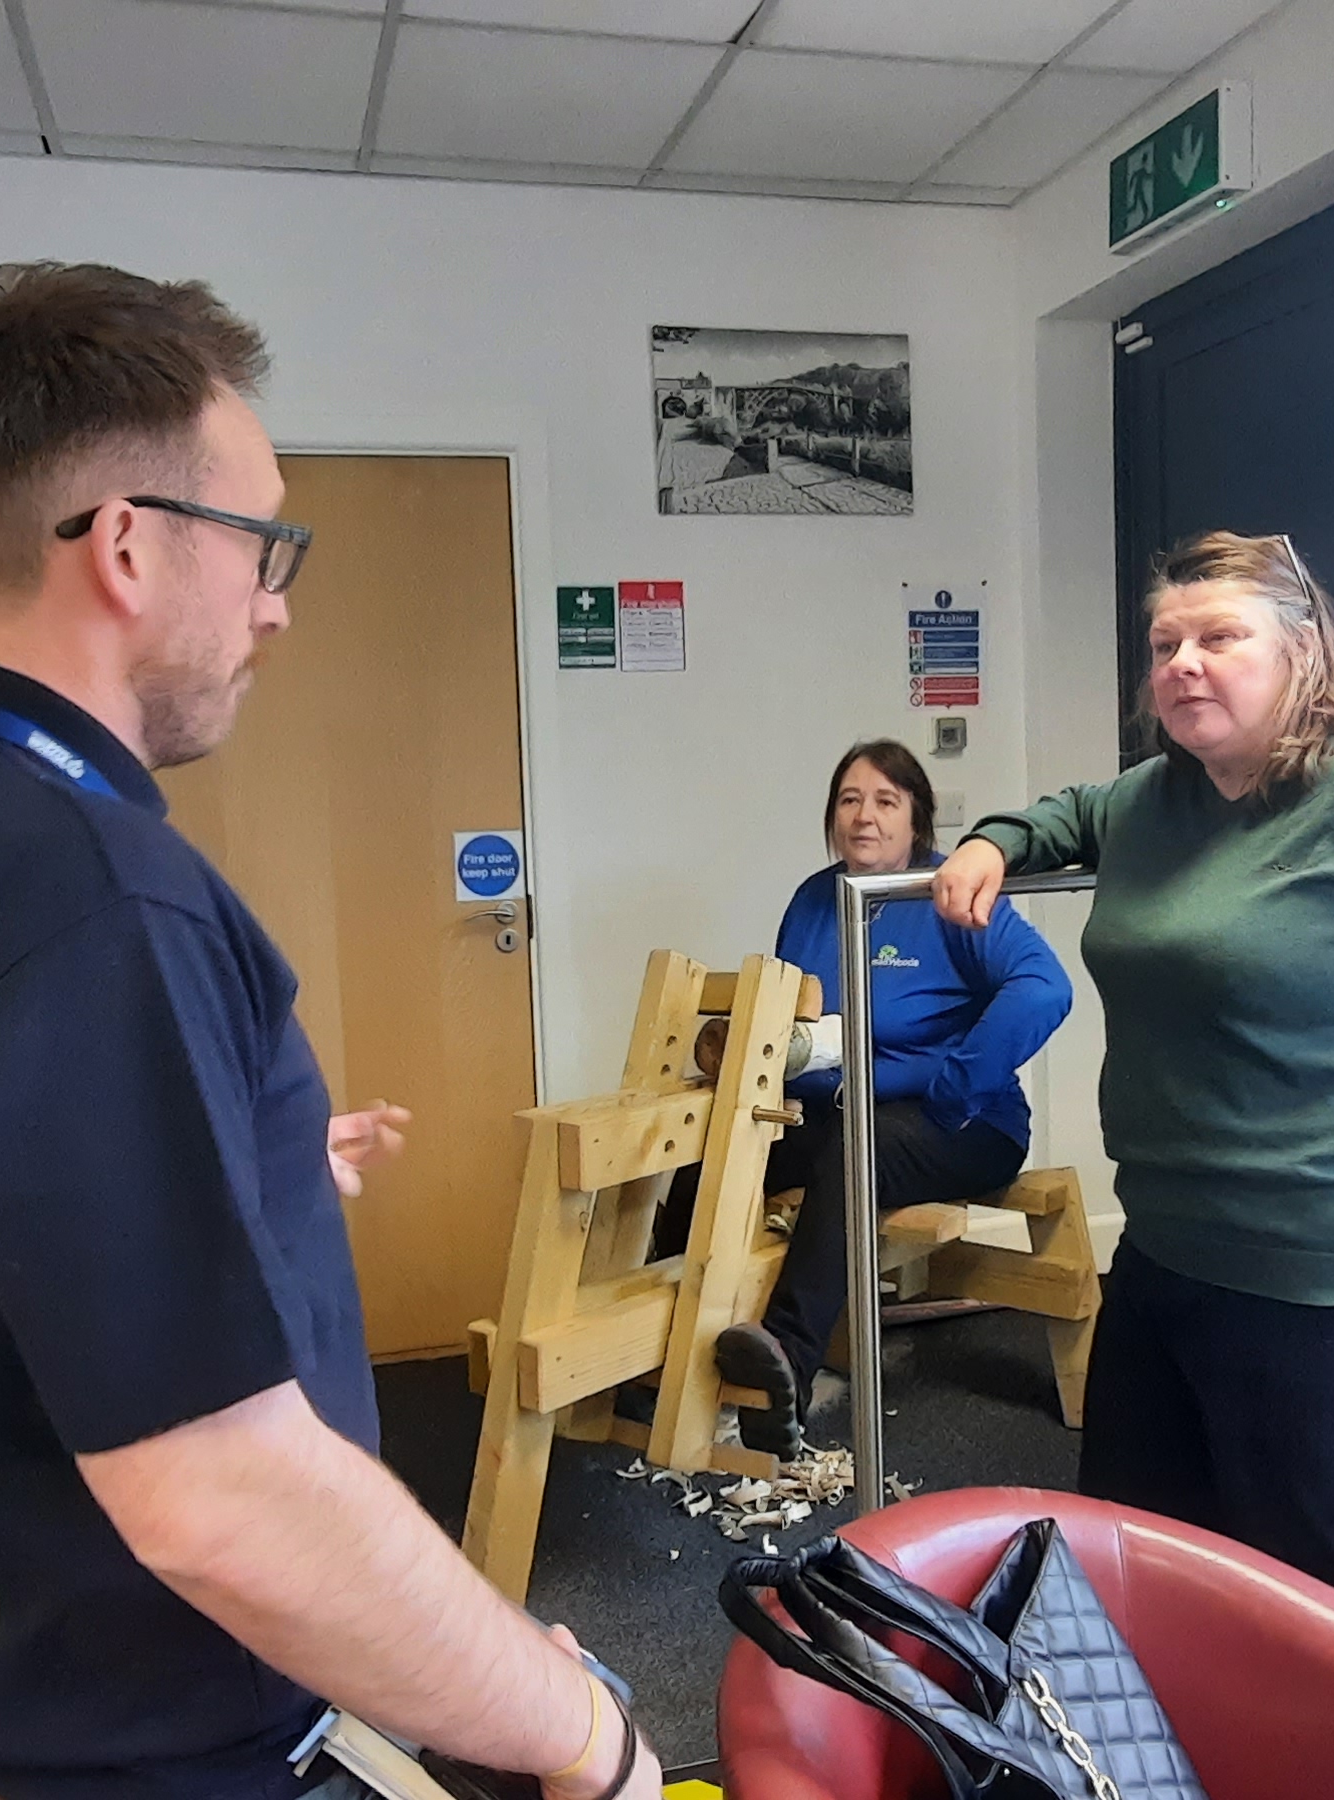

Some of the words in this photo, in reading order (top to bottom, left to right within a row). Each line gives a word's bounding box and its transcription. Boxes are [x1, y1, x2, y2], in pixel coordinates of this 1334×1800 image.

[915, 614, 936, 625] Fire
[938, 614, 973, 625] Action
[463, 854, 486, 865] Fire
[487, 853, 514, 864] door
[462, 868, 488, 880] keep
[491, 867, 516, 877] shut
